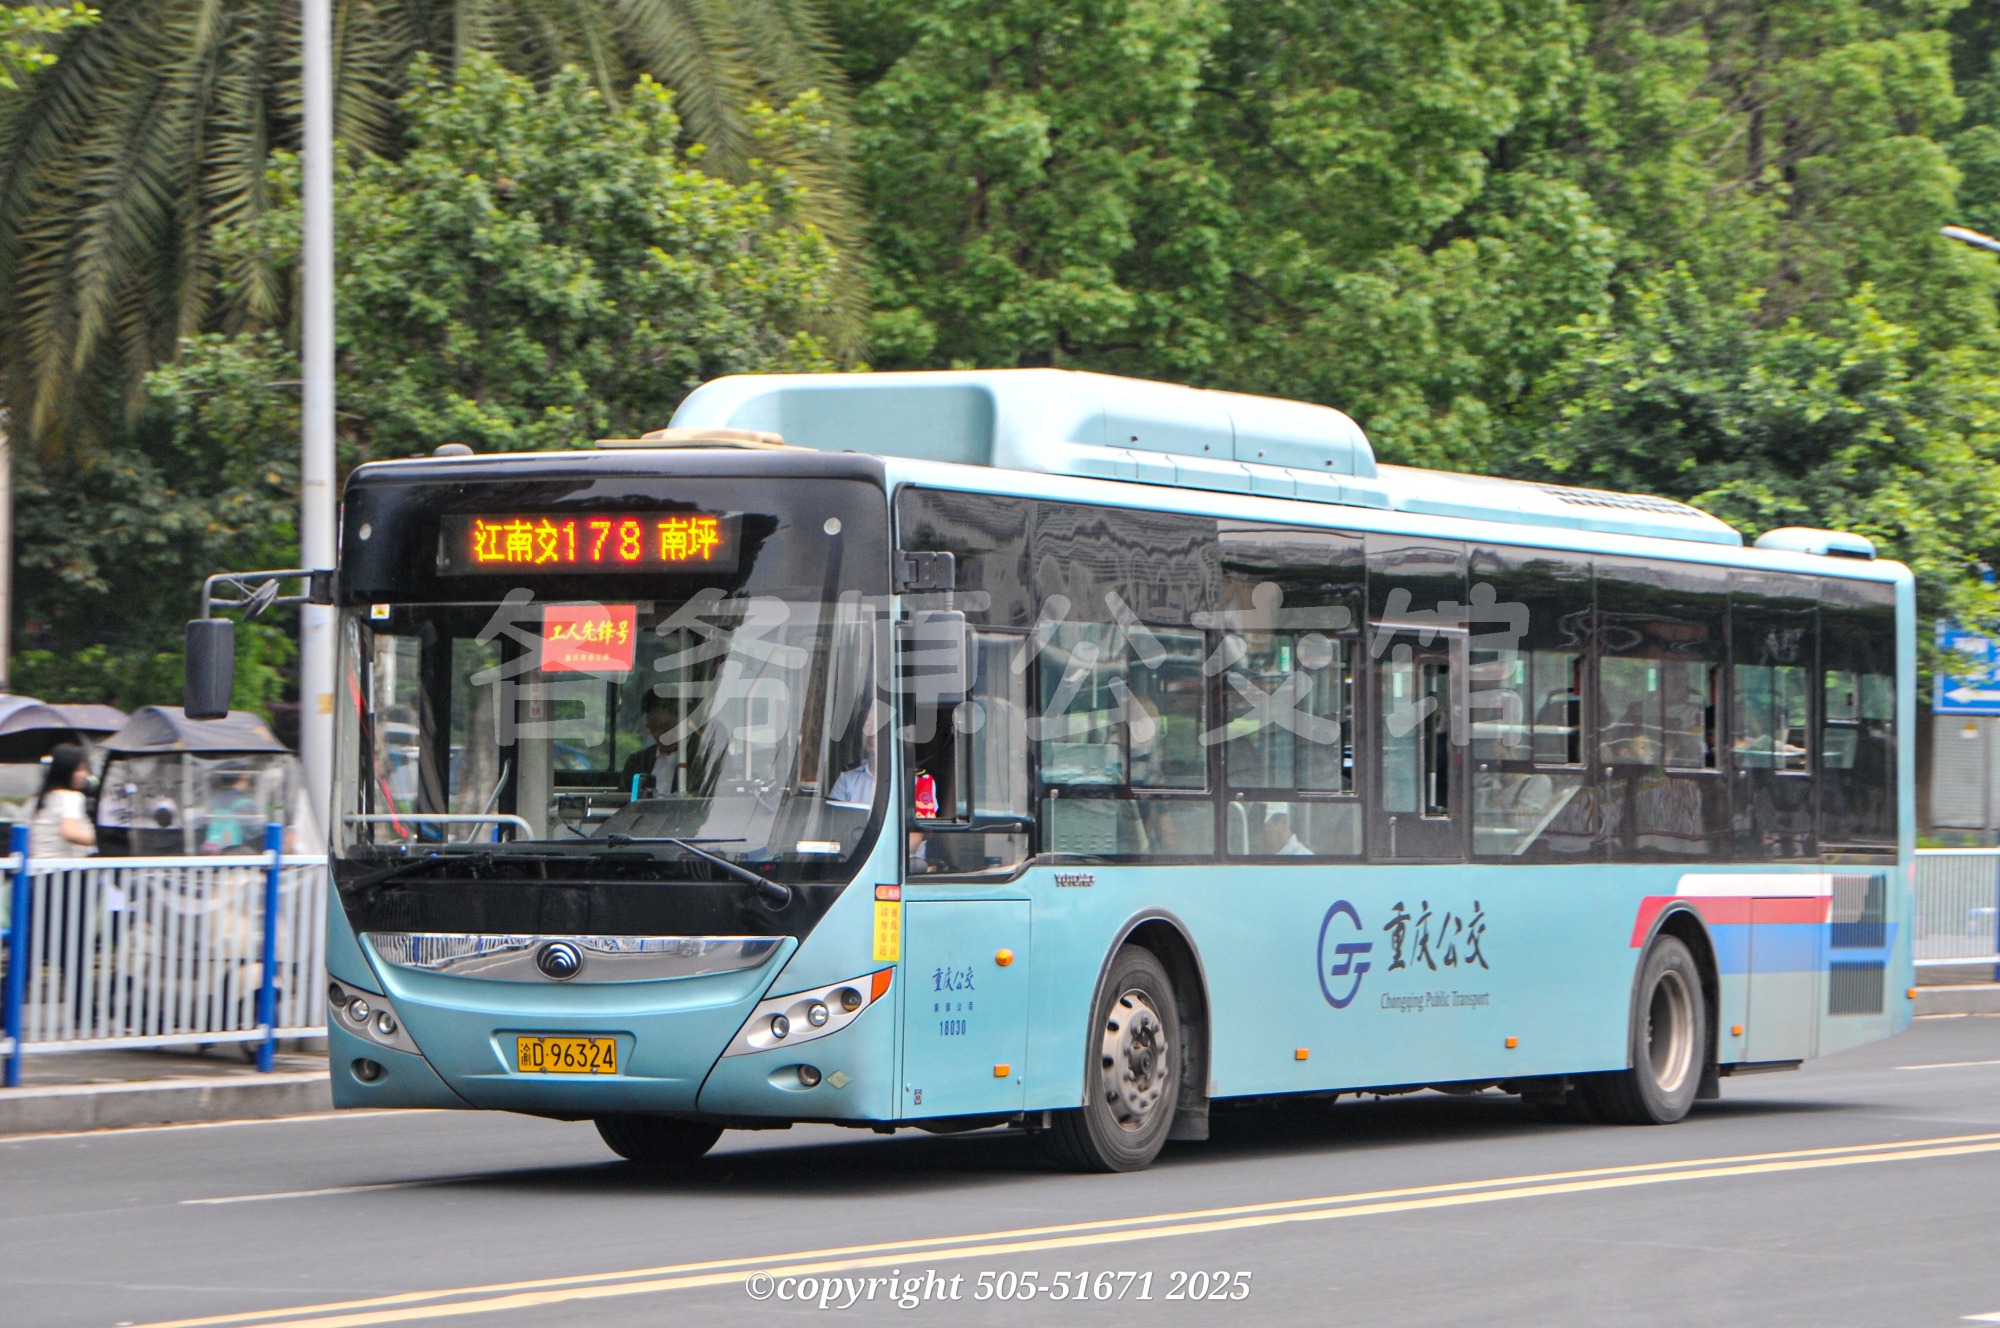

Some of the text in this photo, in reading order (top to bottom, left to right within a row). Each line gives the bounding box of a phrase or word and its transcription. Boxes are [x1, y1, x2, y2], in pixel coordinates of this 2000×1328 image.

[657, 517, 719, 561] 南坪
[548, 619, 630, 646] 工人先锋号
[1384, 900, 1489, 971] 重庆公交
[932, 966, 975, 992] 重庆公交
[1425, 990, 1450, 1008] Public
[1451, 990, 1490, 1010] Transport
[939, 1019, 967, 1036] 18030
